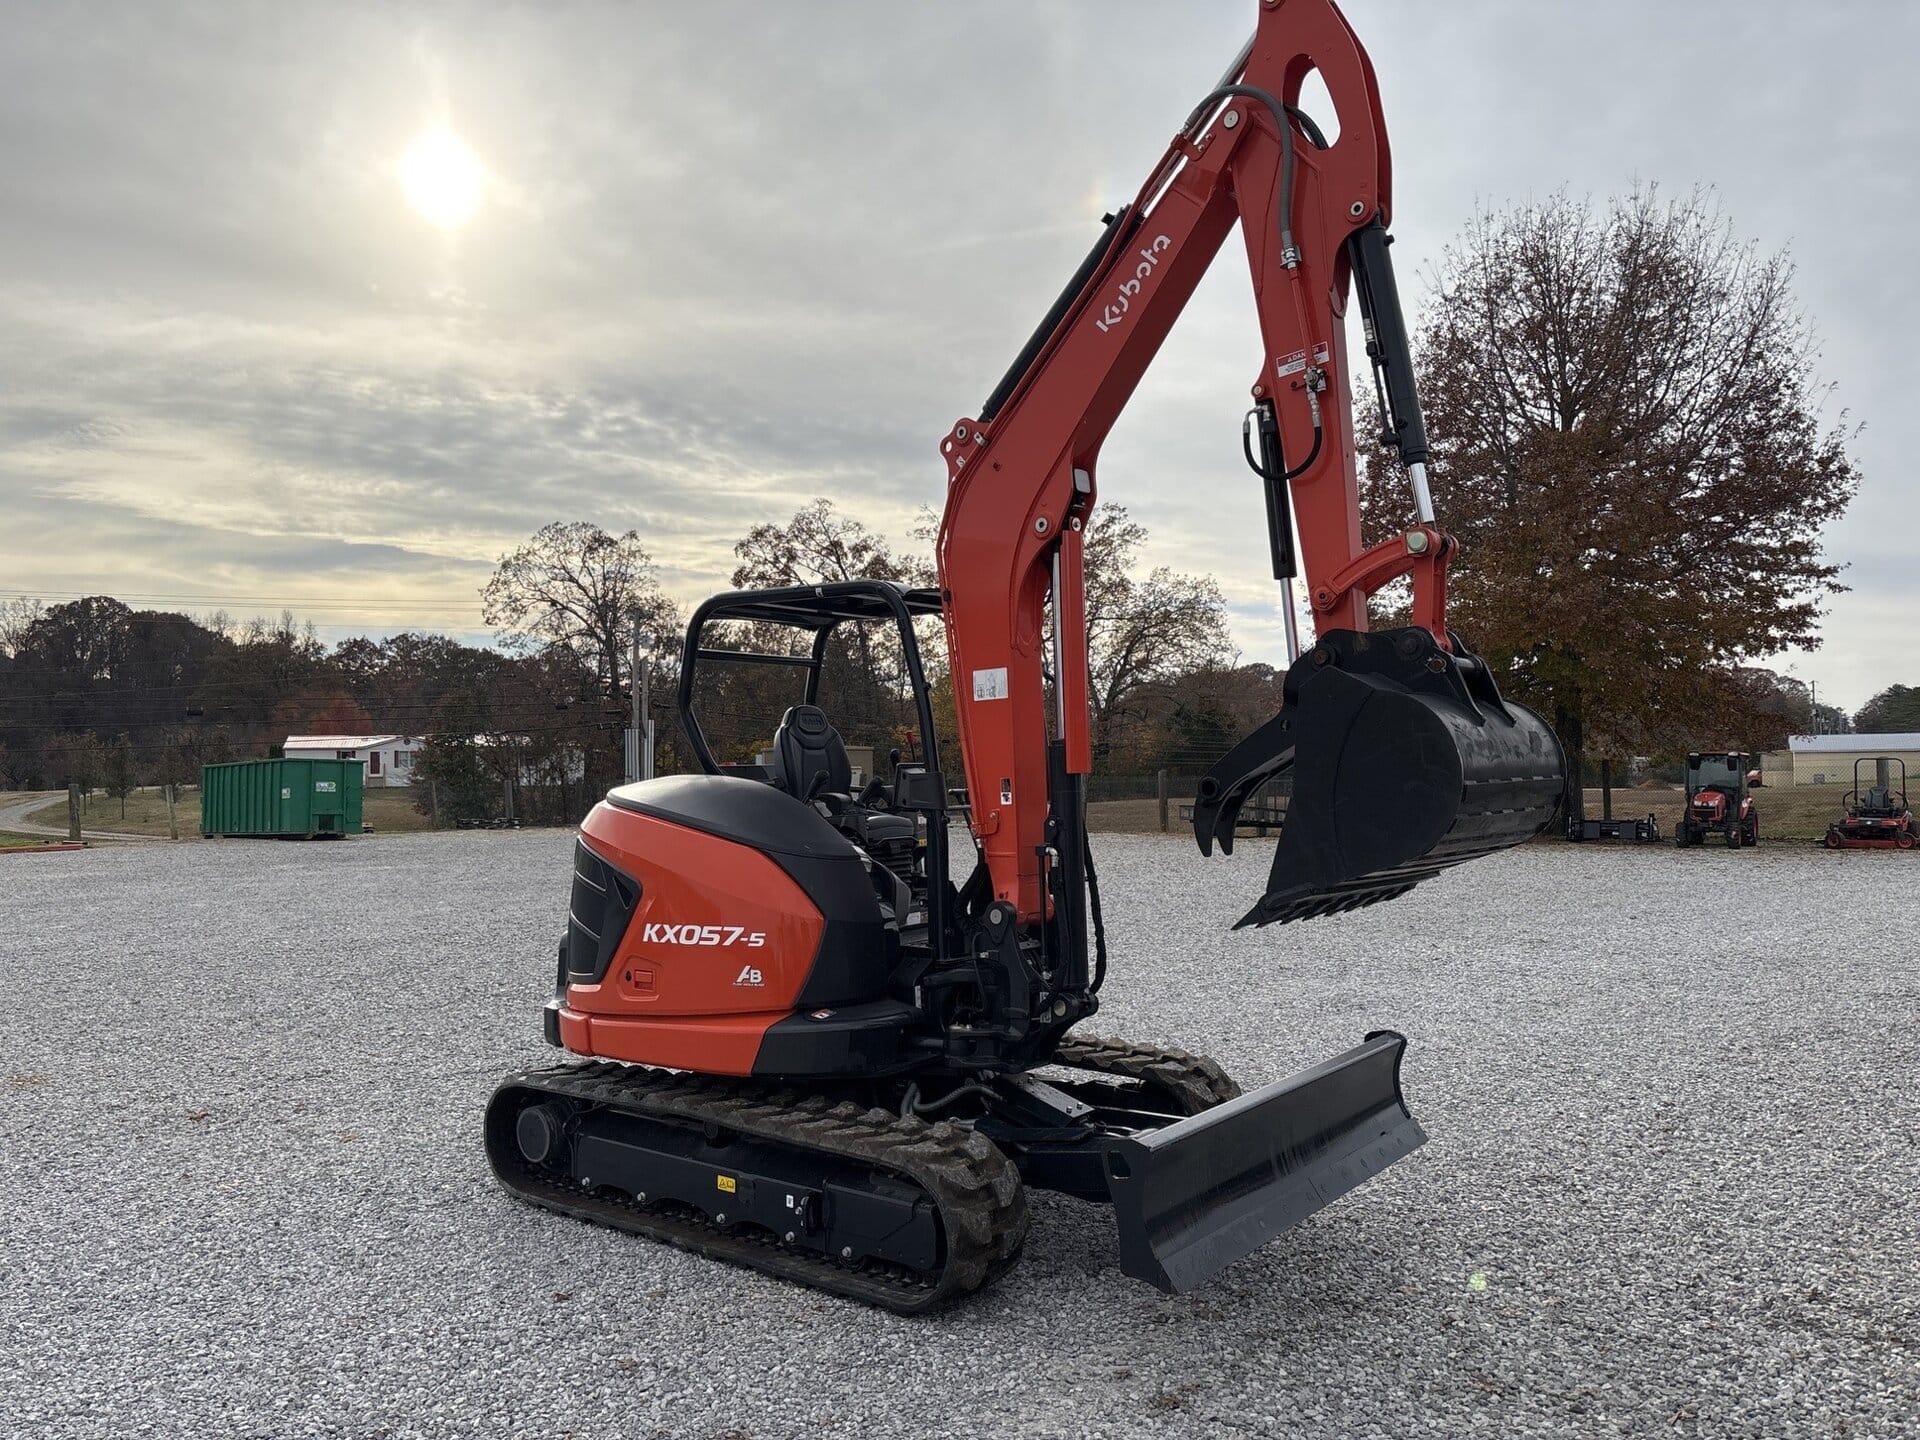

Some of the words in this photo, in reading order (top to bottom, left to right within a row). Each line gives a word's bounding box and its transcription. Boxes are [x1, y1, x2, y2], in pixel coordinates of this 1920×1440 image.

[1096, 235, 1171, 332] Kubota
[1292, 346, 1319, 361] DANR
[642, 923, 766, 947] KX057-5
[736, 965, 762, 983] AB
